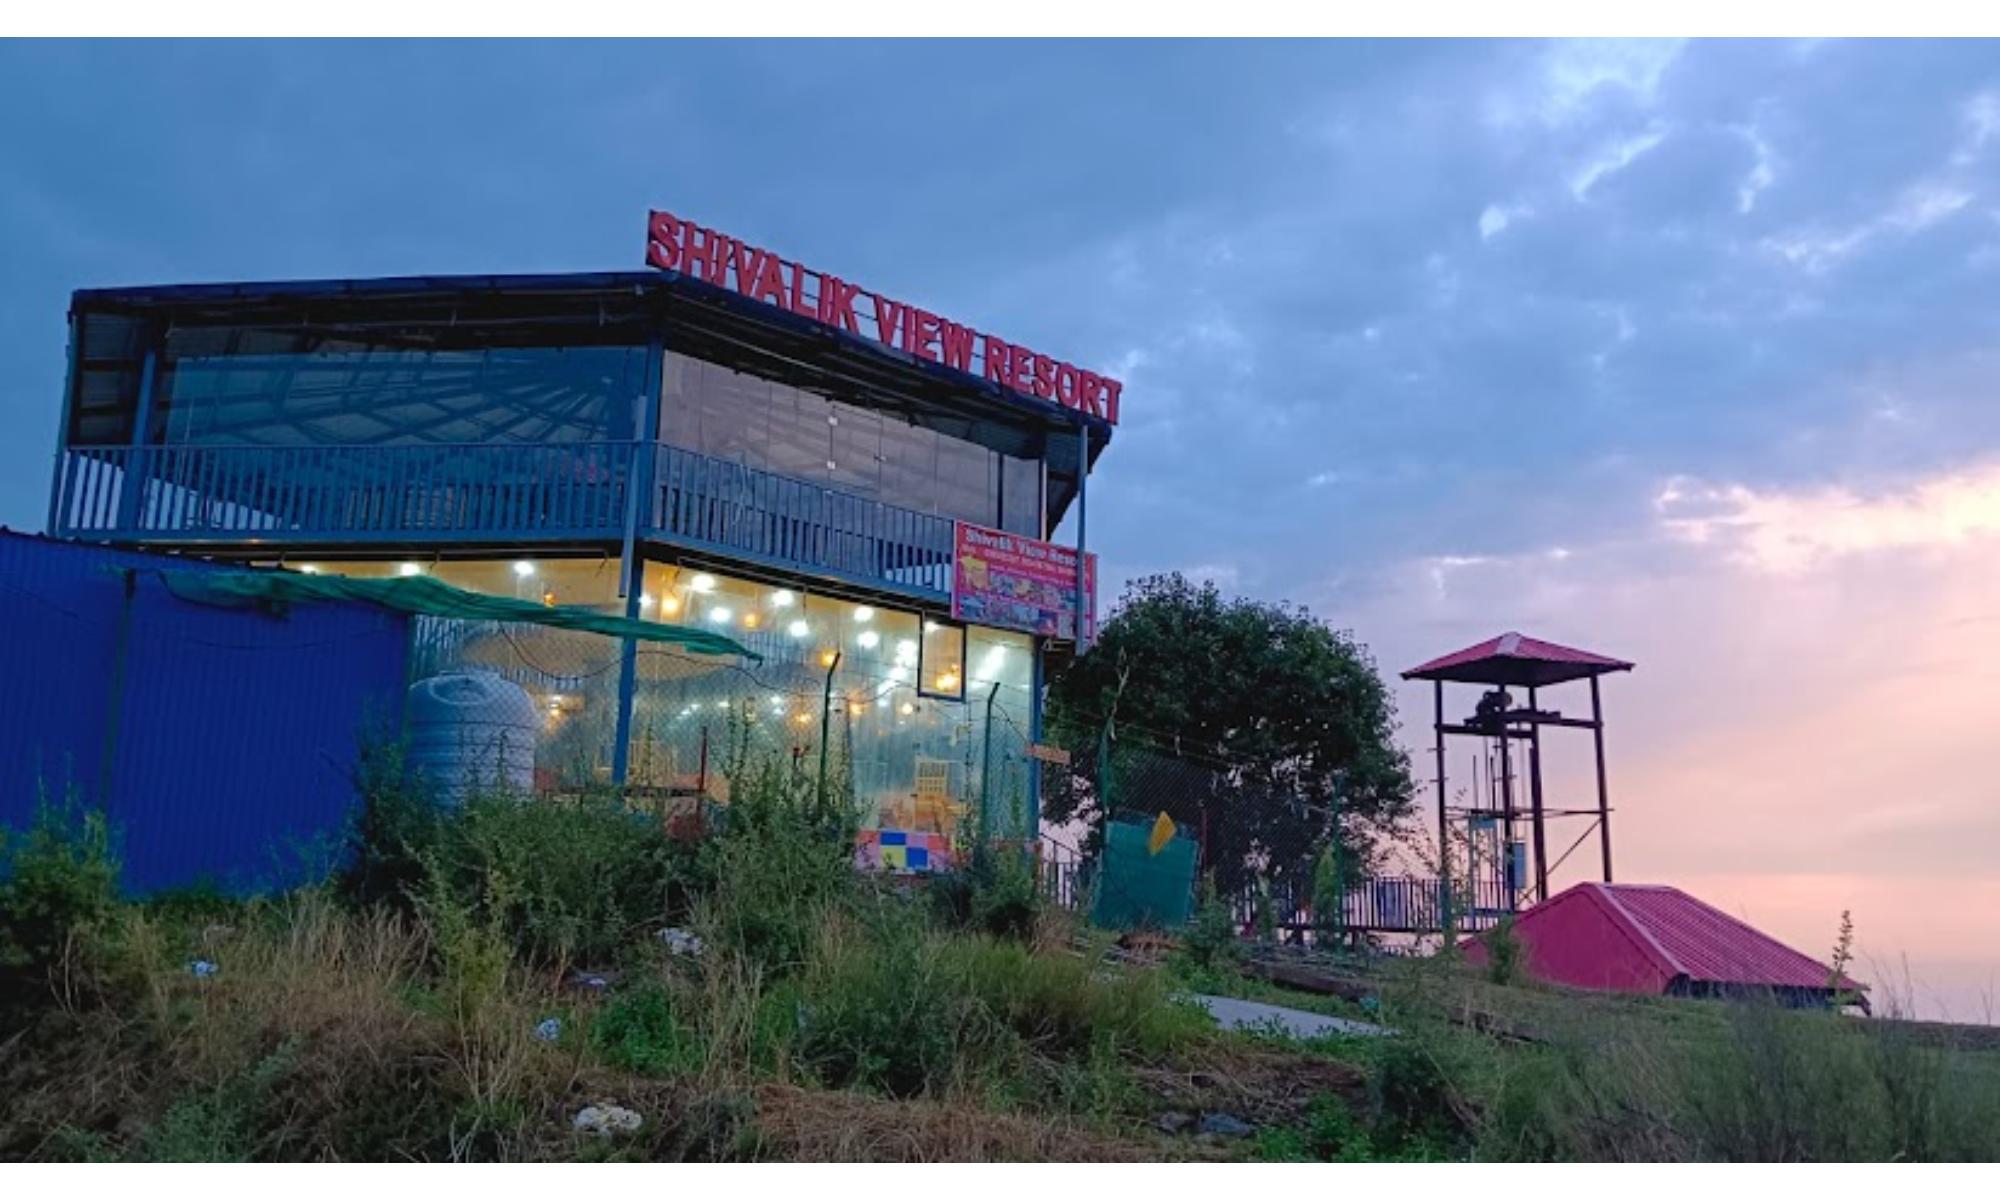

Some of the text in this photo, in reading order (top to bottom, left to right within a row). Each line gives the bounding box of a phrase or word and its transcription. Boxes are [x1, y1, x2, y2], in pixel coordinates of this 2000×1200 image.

[648, 211, 1121, 426] SHIVALIK VIEW RESORT
